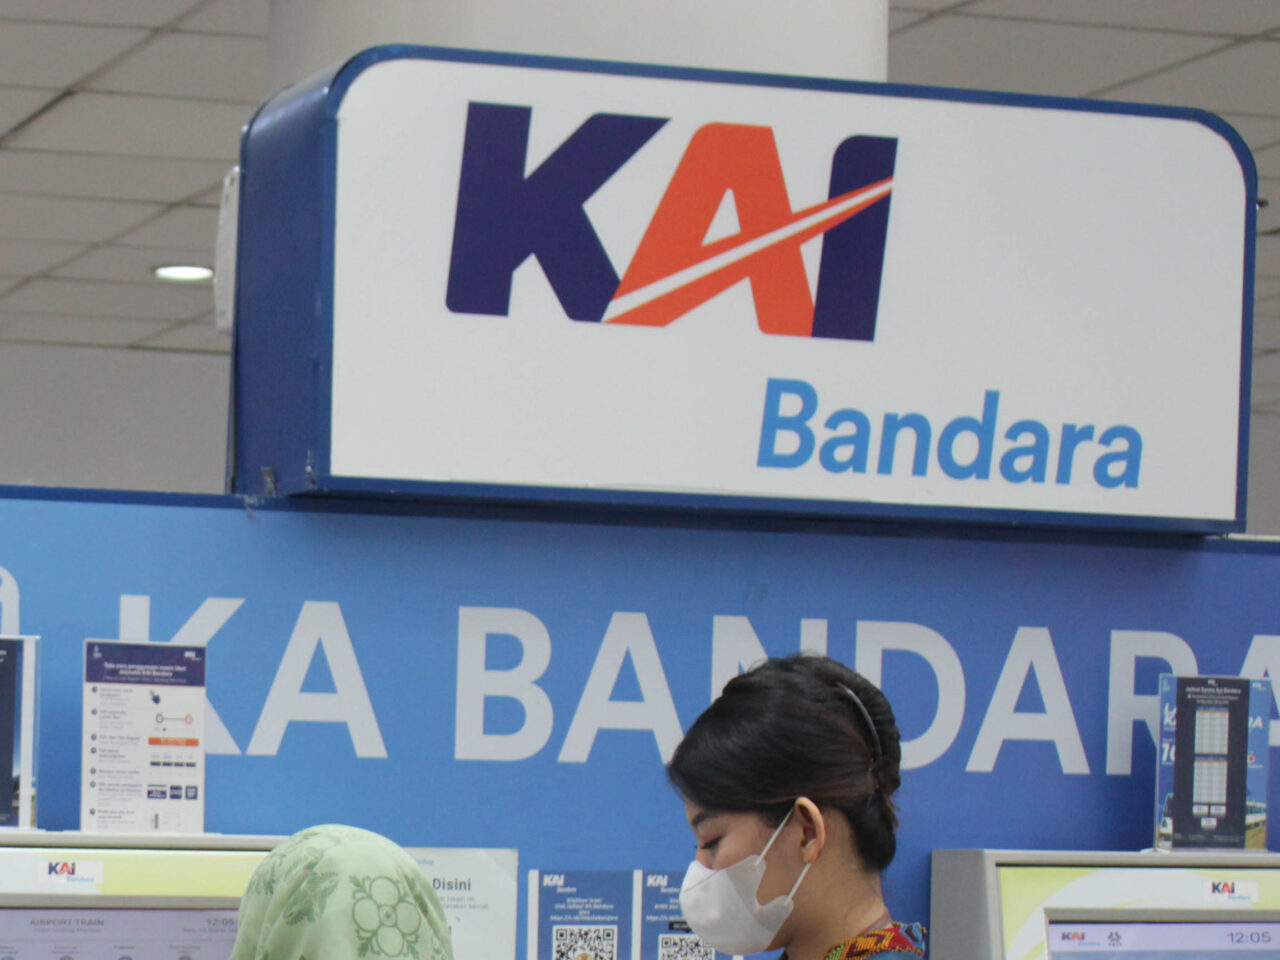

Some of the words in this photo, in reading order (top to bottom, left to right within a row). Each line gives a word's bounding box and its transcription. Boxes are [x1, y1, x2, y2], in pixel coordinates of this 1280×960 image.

[445, 101, 898, 342] KAI
[756, 378, 1143, 490] Bandara
[454, 606, 1280, 777] BADAR
[432, 878, 471, 891] Disini
[1227, 931, 1271, 944] 12:05
